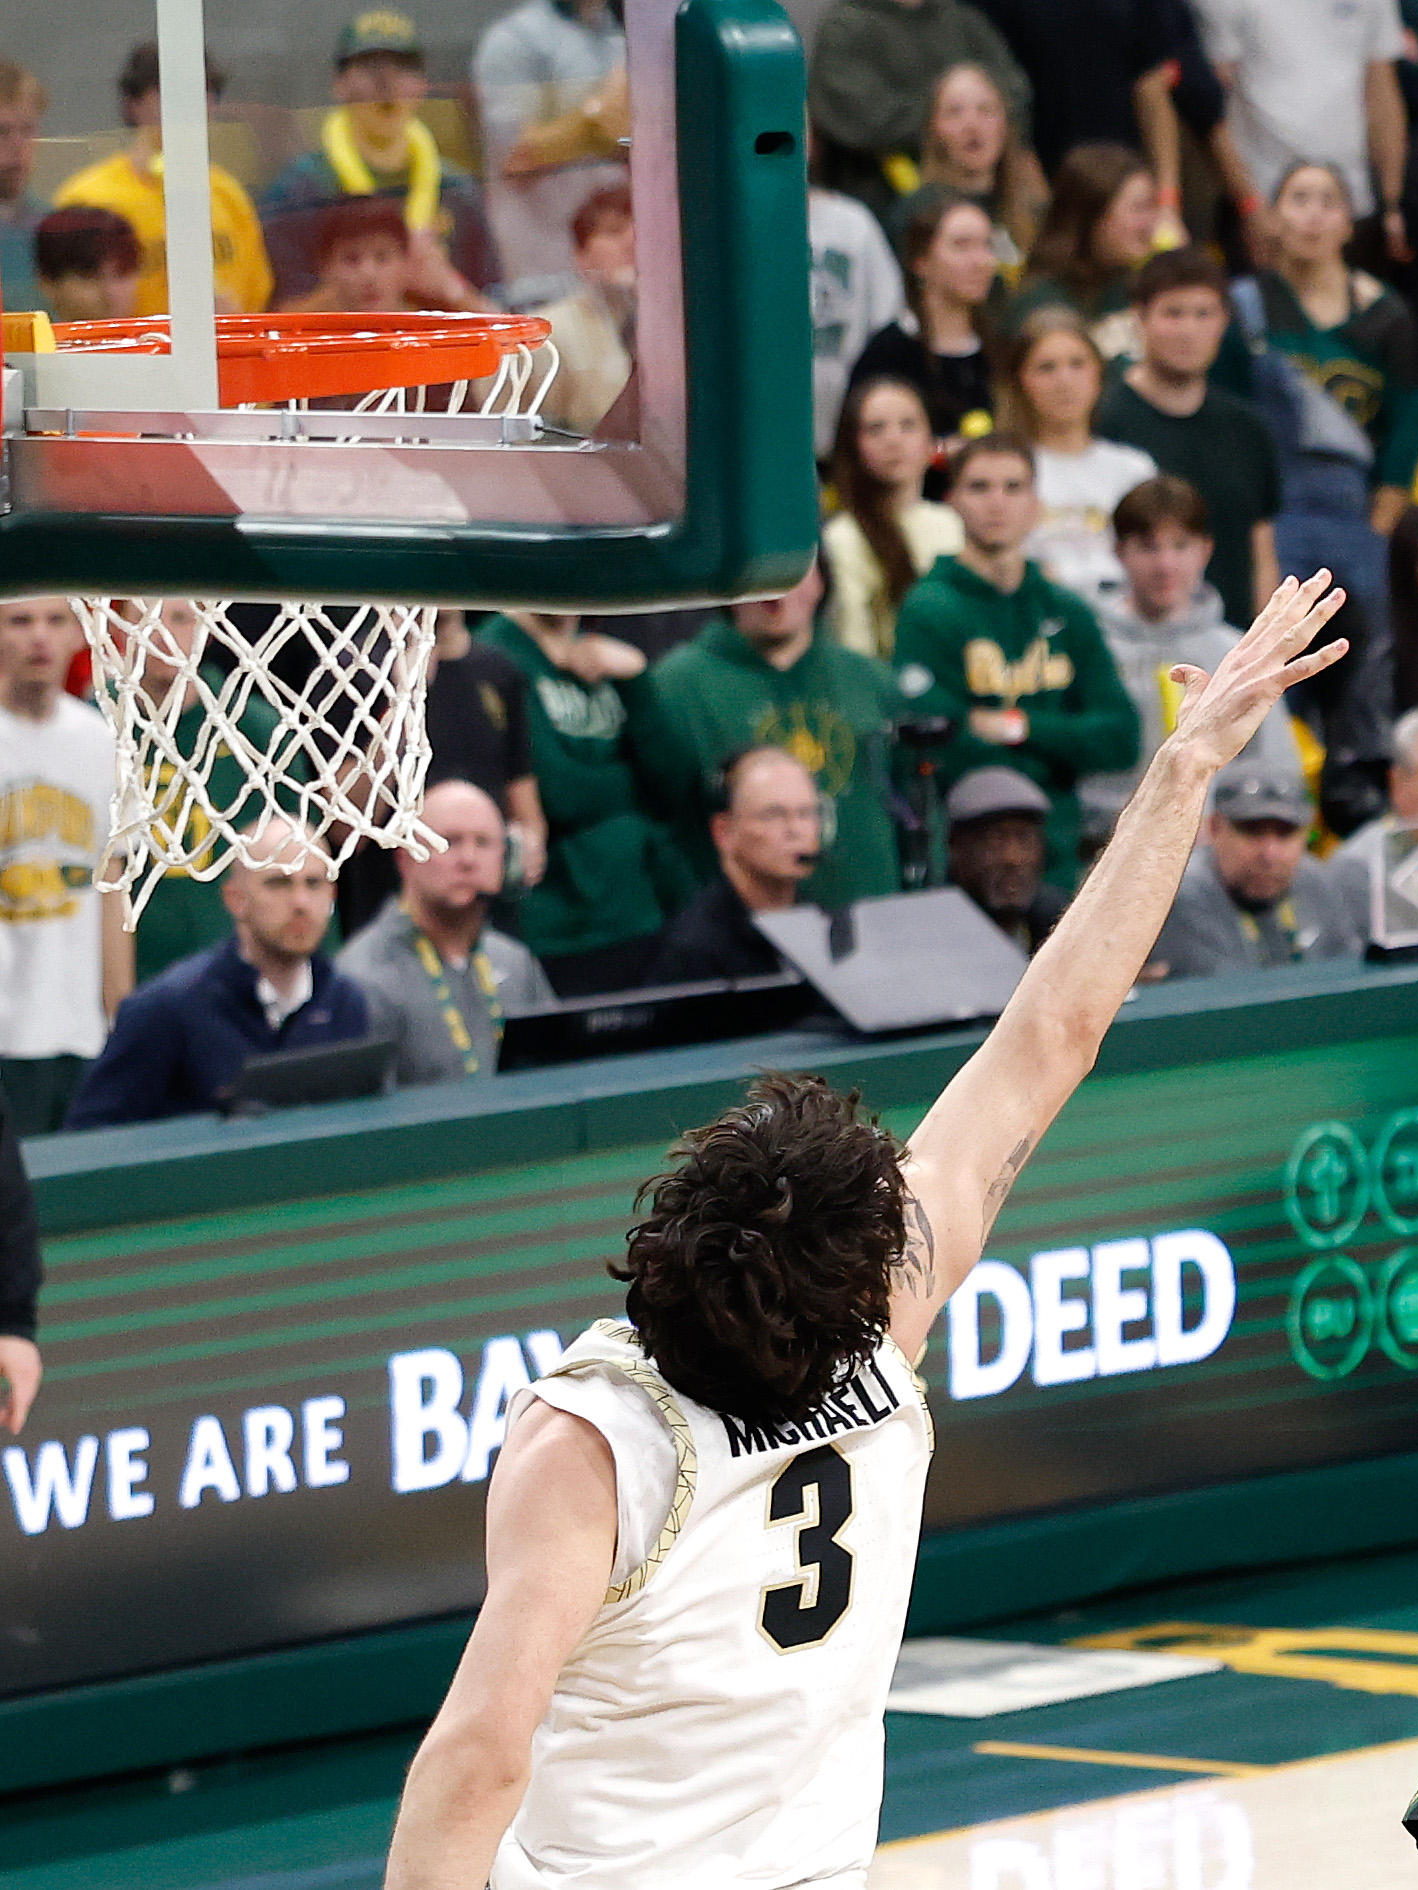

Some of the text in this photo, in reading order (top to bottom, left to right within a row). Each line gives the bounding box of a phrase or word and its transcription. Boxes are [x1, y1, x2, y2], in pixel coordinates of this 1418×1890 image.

[947, 1226, 1239, 1402] DEED
[1, 1426, 157, 1537] WE
[177, 1393, 352, 1510] ARE
[755, 1443, 858, 1656] 3
